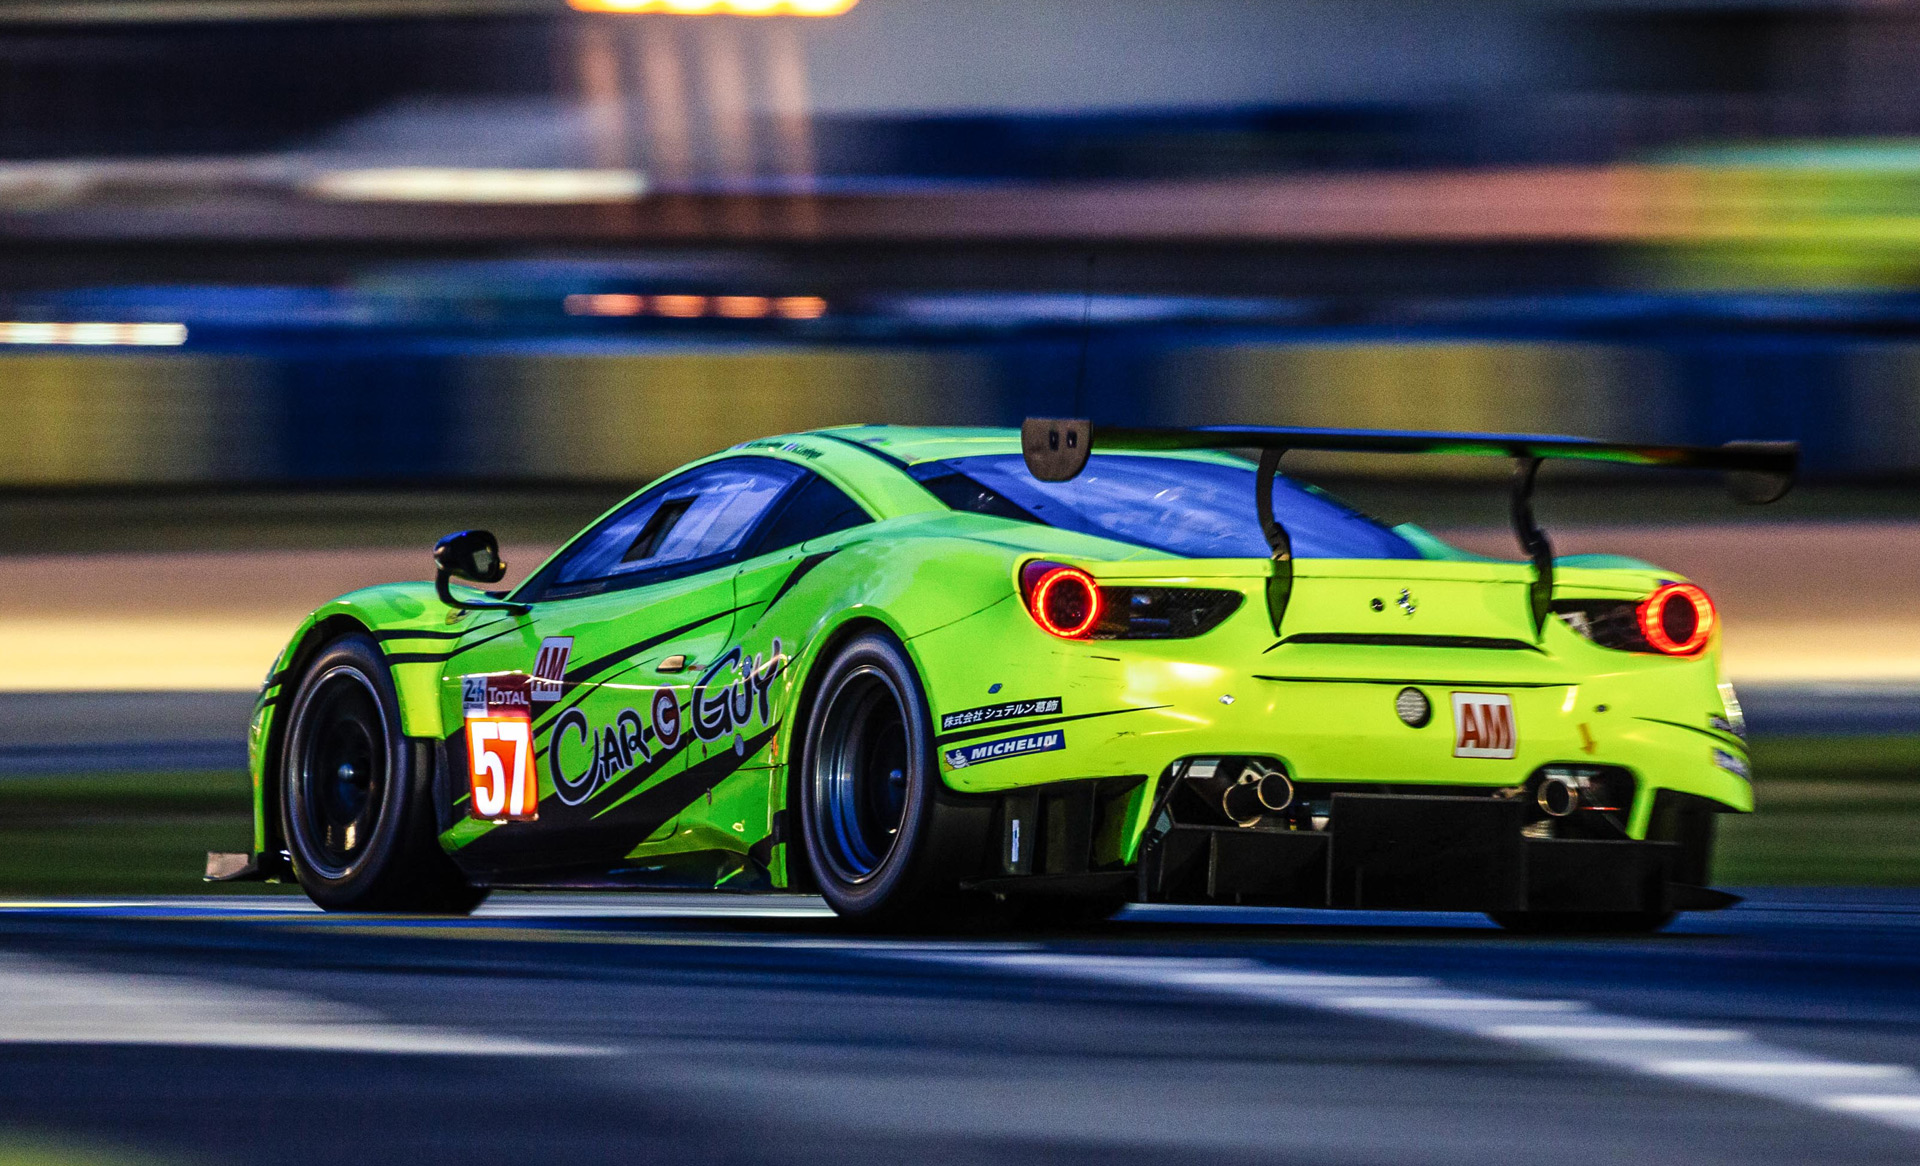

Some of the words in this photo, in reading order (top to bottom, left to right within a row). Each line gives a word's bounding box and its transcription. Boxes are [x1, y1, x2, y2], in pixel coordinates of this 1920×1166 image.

[532, 647, 569, 692] AM
[691, 636, 782, 743] GUY
[487, 687, 529, 705] TOTAL
[971, 734, 1059, 760] MICHELIN
[1459, 702, 1512, 750] AM
[470, 721, 529, 817] 57
